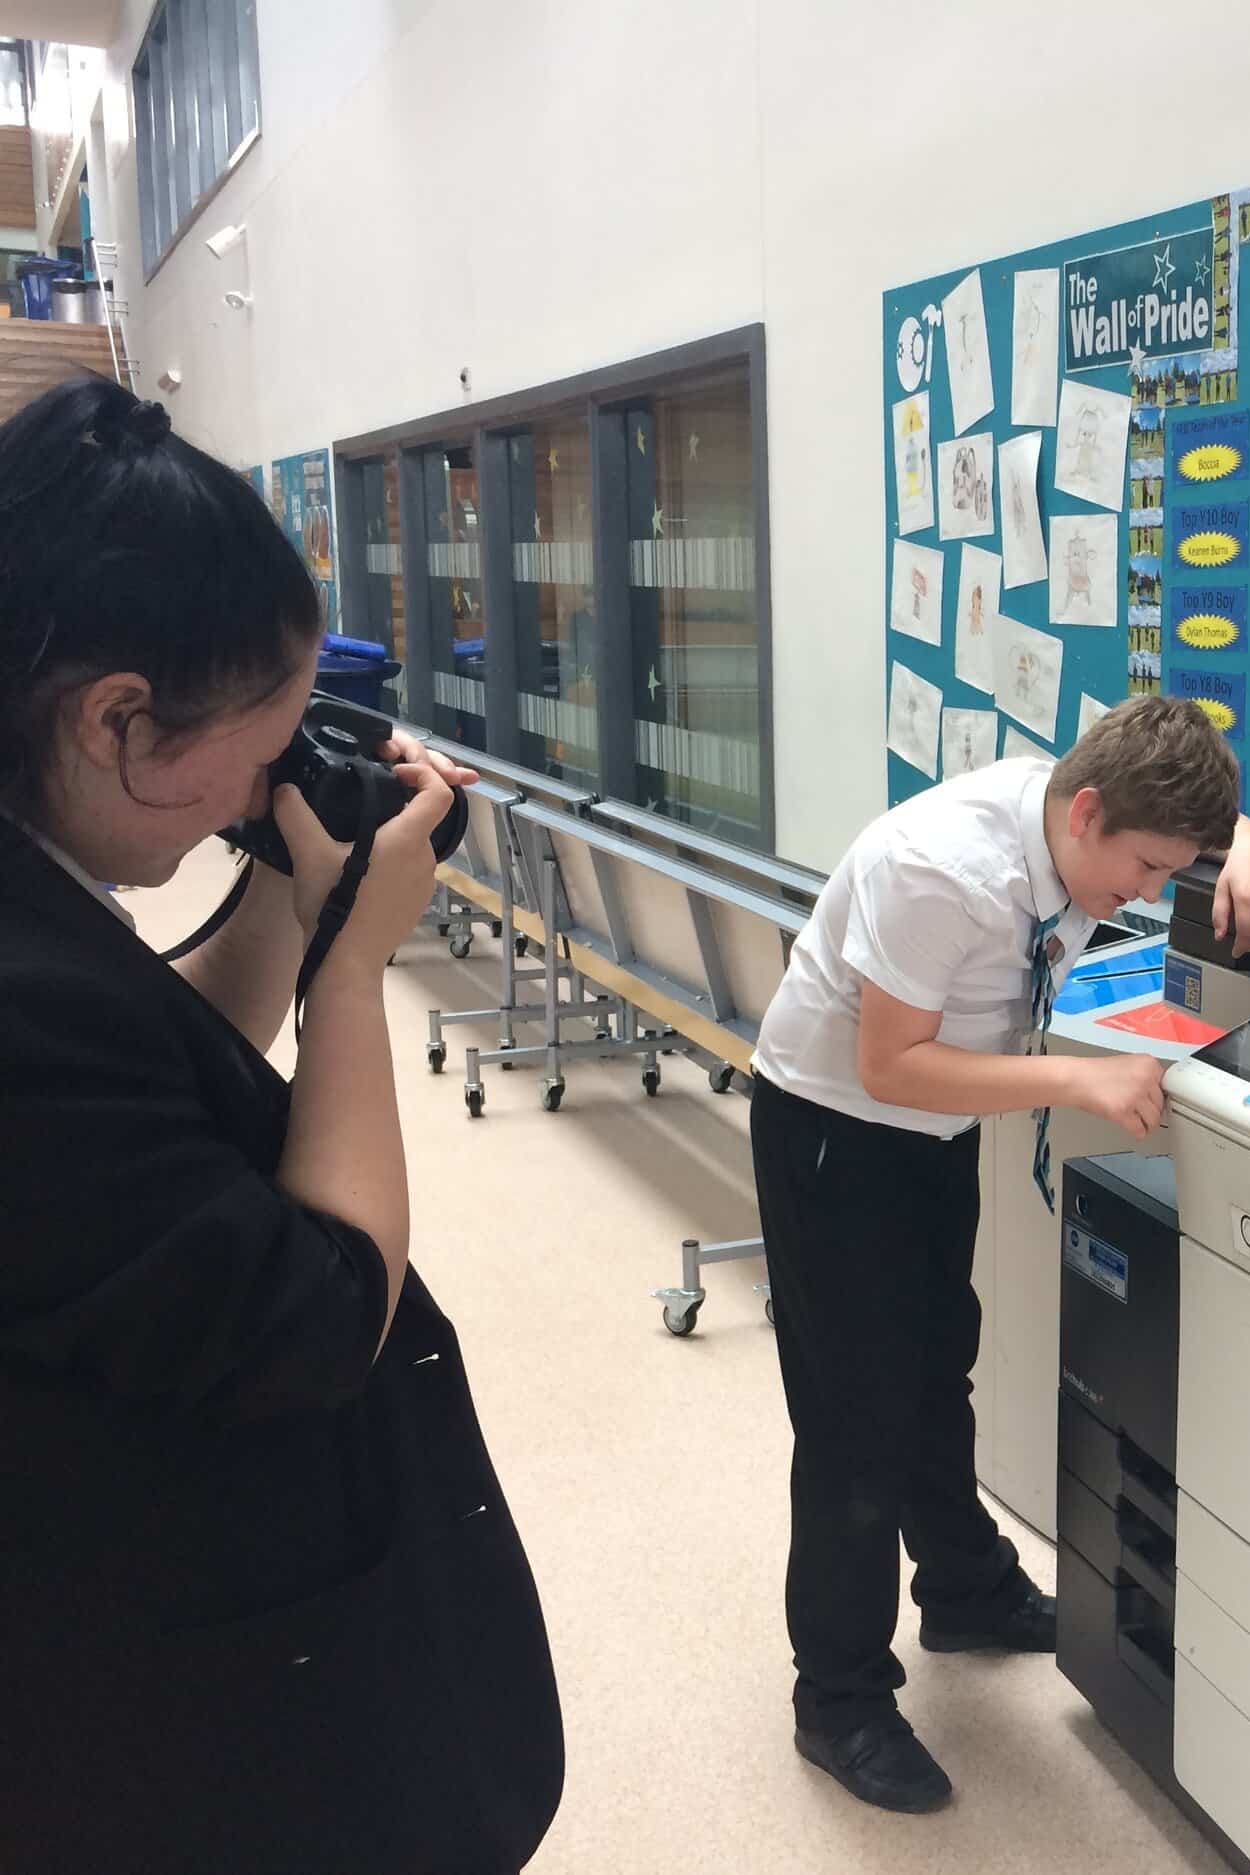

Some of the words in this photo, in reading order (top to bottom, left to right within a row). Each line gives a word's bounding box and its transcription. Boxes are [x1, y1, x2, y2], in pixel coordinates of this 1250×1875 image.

[1068, 271, 1097, 305] The
[1070, 299, 1126, 358] Wall
[1127, 294, 1144, 328] of
[1144, 286, 1209, 346] Pride
[1181, 511, 1198, 530] Top
[1199, 508, 1218, 526] Y10
[1220, 507, 1240, 529] Boy
[1182, 591, 1199, 611] Top
[1201, 591, 1214, 609] Y9
[1216, 591, 1235, 613] Boy
[1203, 626, 1228, 639] Thomas
[1181, 673, 1198, 692] Top
[1200, 675, 1212, 693] Y8
[1214, 676, 1233, 697] Boy
